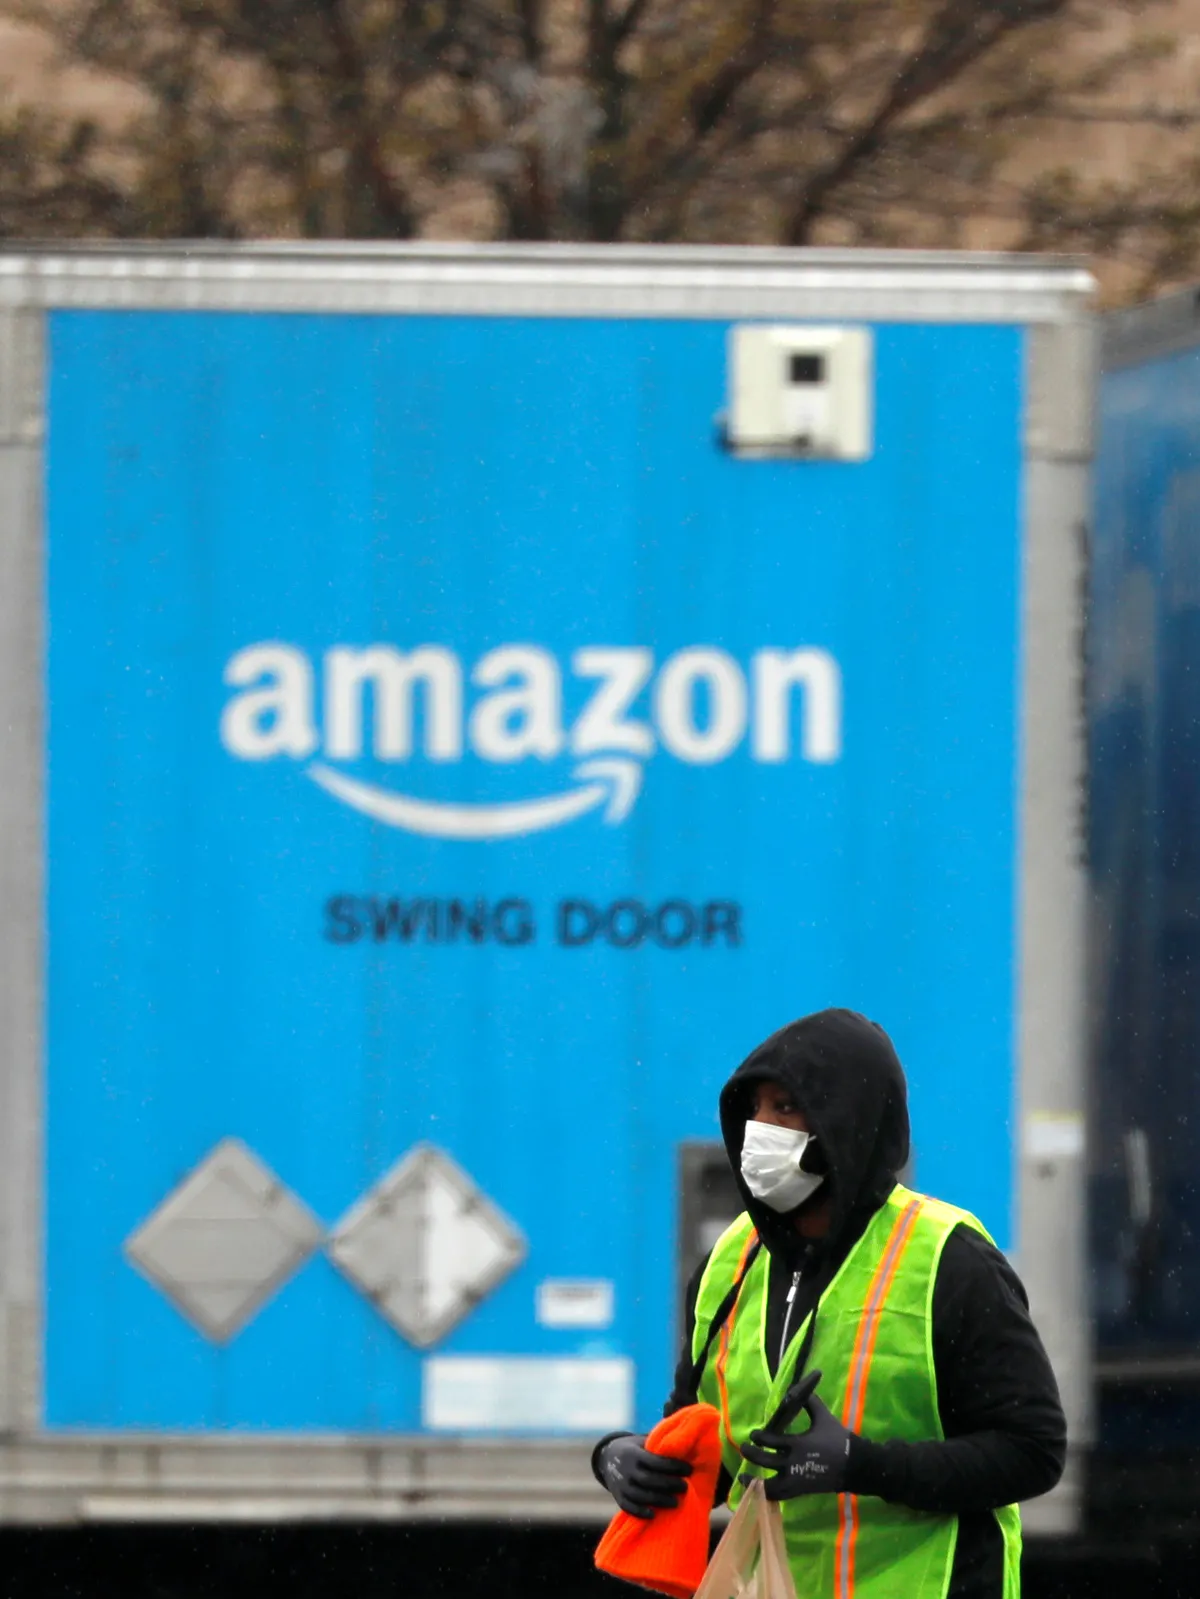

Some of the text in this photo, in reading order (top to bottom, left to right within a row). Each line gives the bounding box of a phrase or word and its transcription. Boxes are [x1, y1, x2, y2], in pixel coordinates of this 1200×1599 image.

[222, 643, 841, 763] amazon
[325, 895, 740, 948] SWING DOOR
